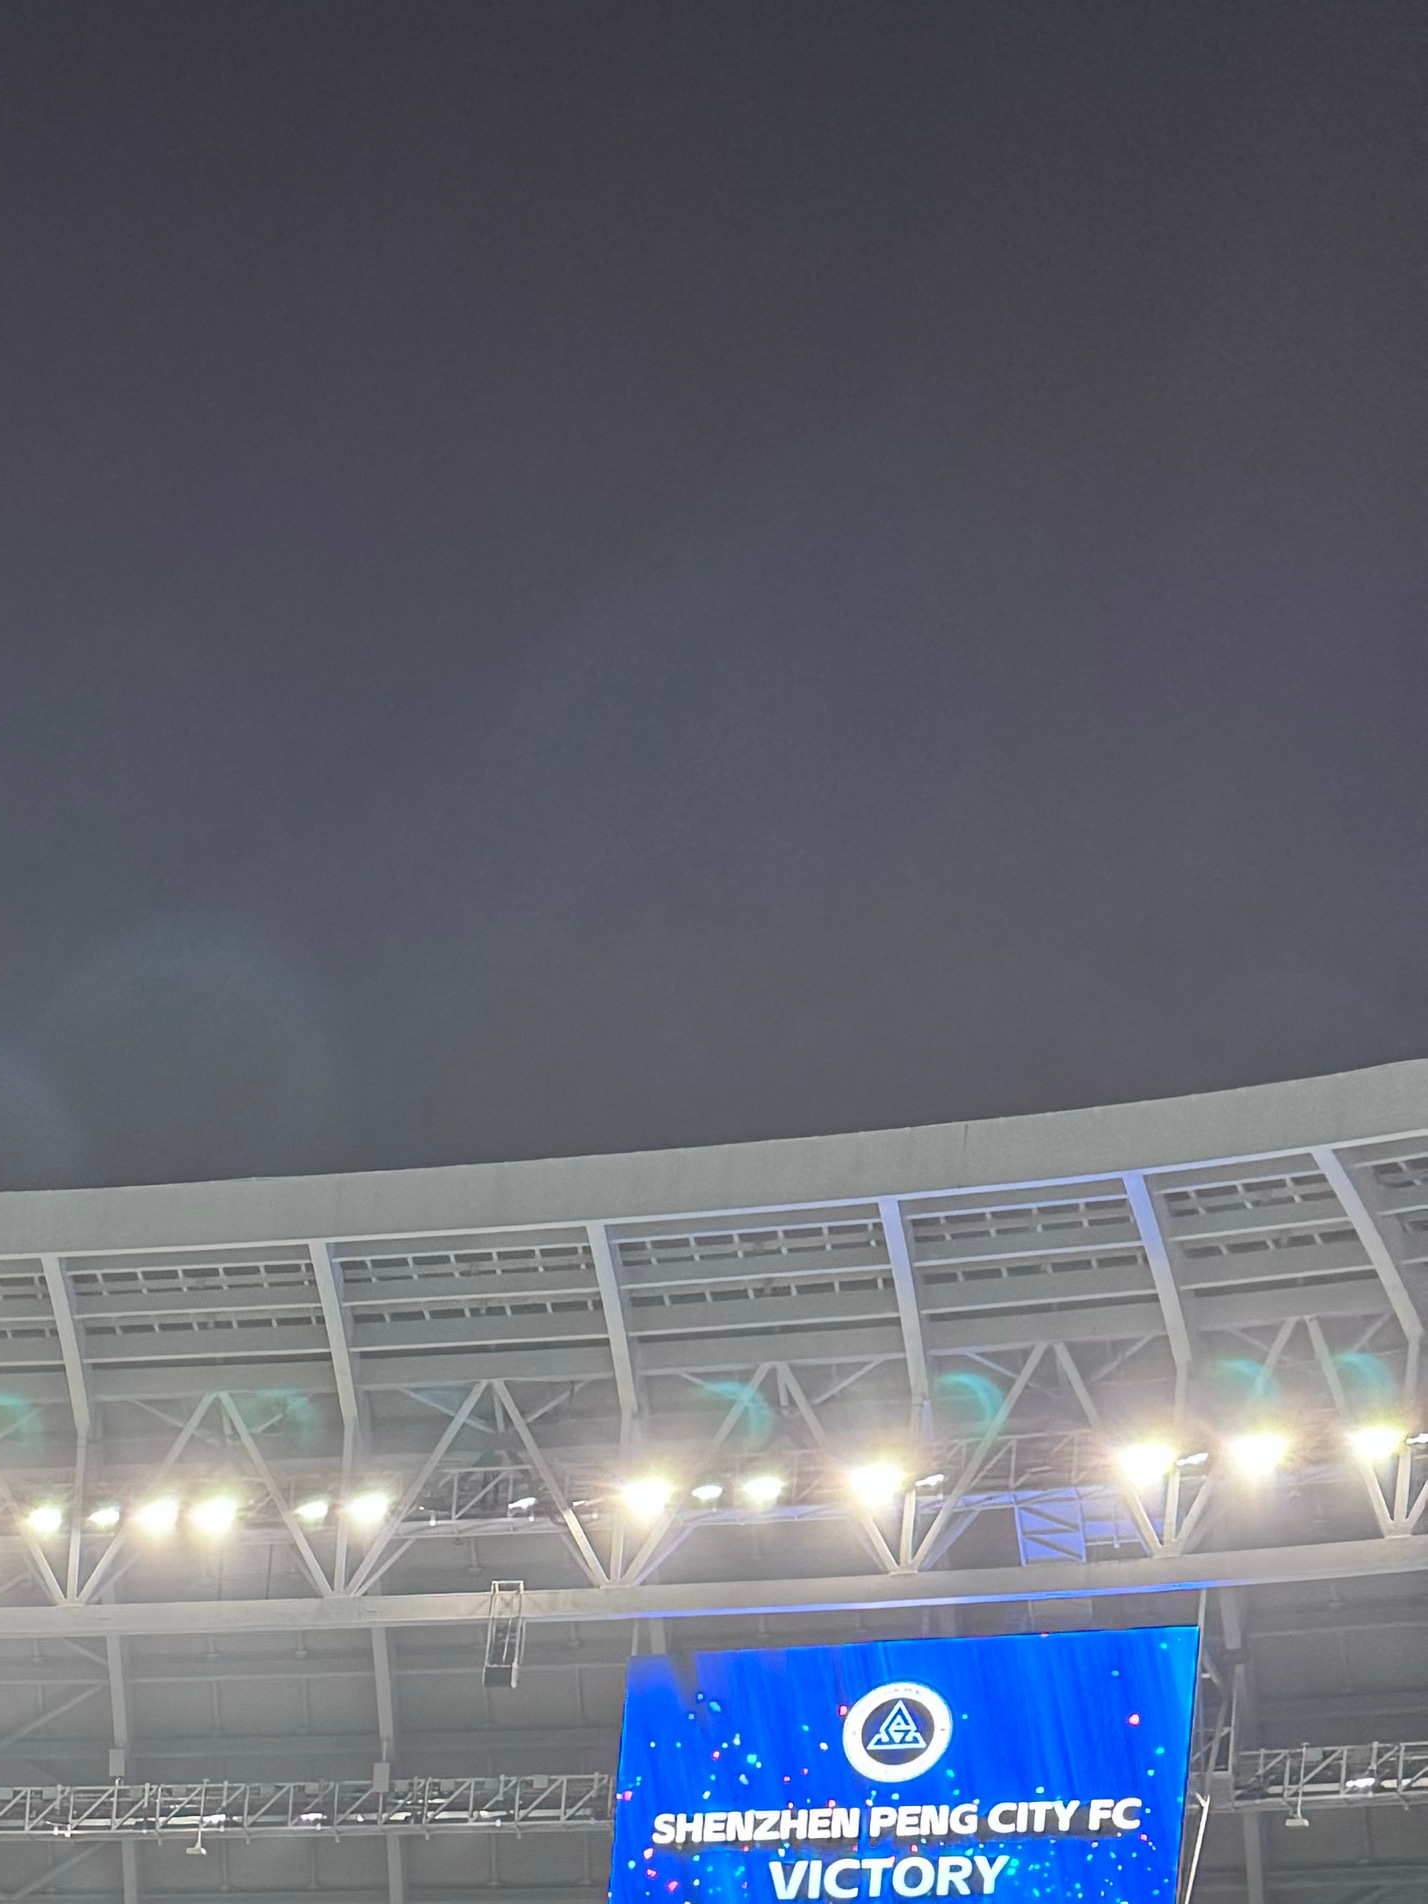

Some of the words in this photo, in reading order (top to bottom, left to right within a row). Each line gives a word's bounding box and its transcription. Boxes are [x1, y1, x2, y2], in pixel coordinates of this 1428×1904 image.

[652, 1805, 860, 1845] SHENZHEN
[869, 1803, 979, 1838] PENG
[987, 1800, 1076, 1834] CITY
[1087, 1797, 1143, 1831] FC
[768, 1854, 1011, 1901] VICTORY
